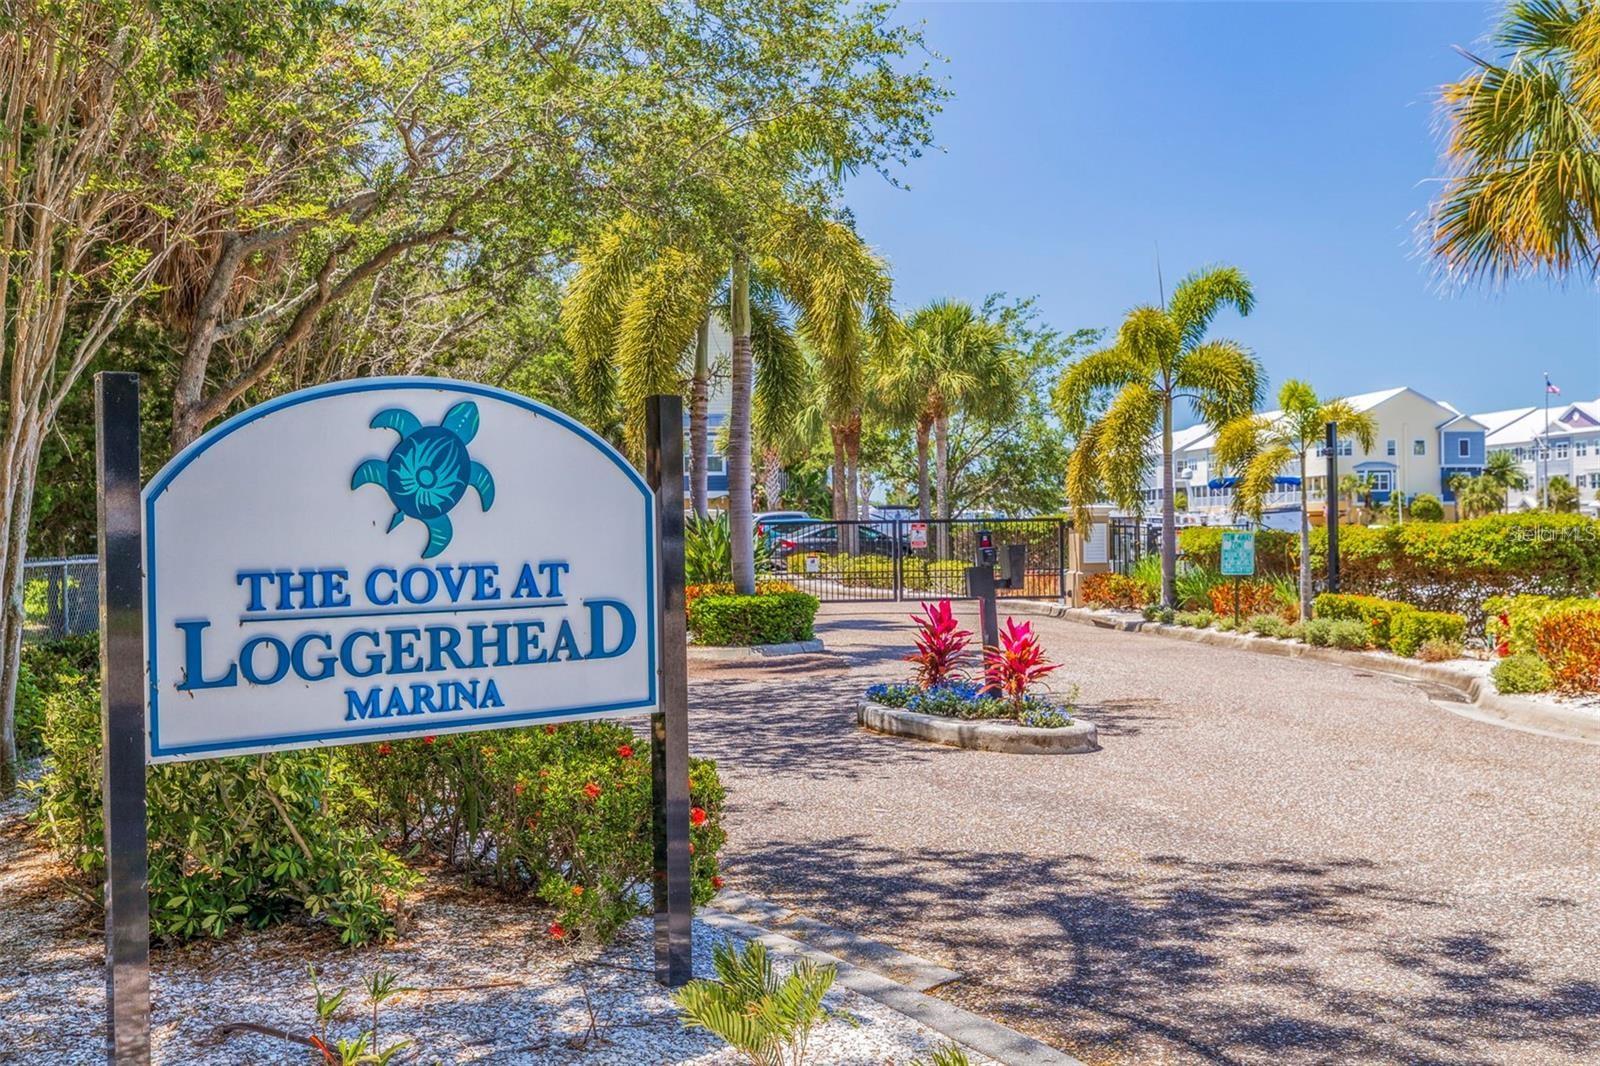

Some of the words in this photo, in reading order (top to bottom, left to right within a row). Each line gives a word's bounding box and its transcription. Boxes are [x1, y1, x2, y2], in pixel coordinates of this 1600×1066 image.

[237, 569, 352, 612] THE
[365, 565, 501, 605] COVE
[511, 563, 570, 598] AT
[175, 599, 637, 691] LOGGERHEAD
[344, 679, 505, 722] MARINA
